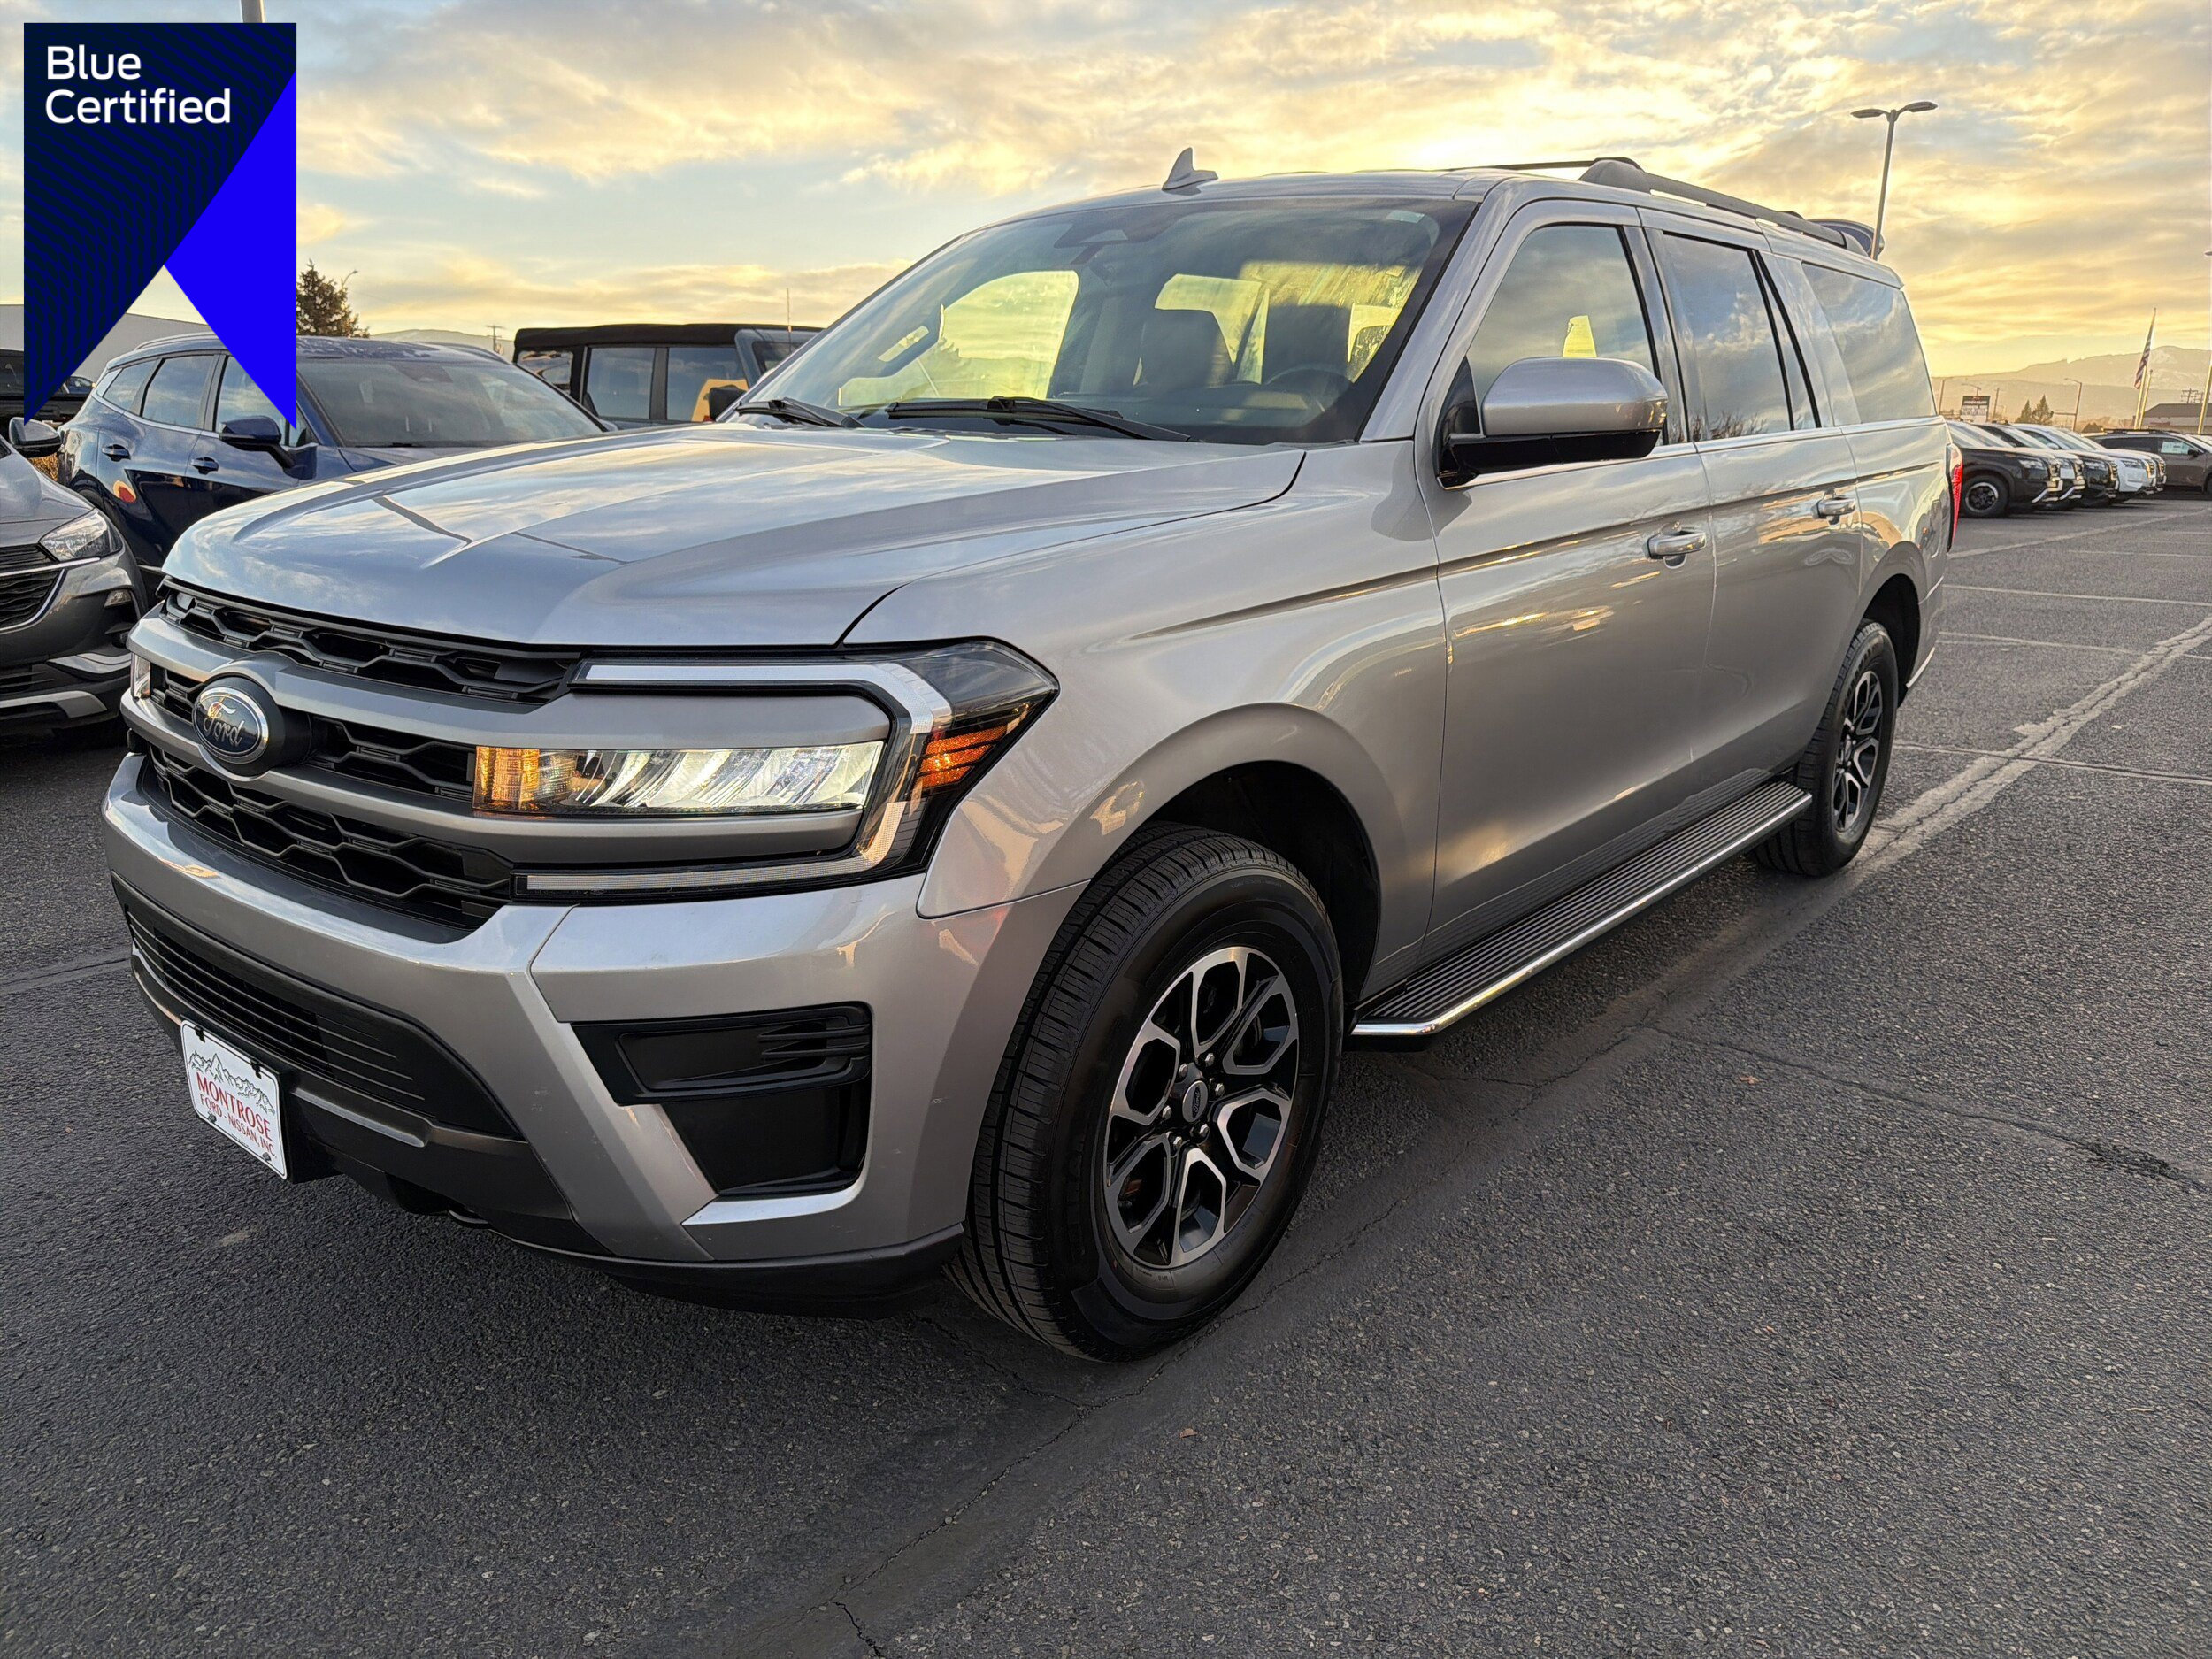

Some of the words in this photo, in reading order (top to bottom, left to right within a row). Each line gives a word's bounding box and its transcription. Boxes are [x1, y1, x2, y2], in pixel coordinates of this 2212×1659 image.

[203, 702, 244, 747] Ford
[196, 1072, 273, 1142] MONTROSE
[200, 1094, 222, 1118] FORD
[228, 1114, 260, 1148] NISSAN,
[259, 1136, 278, 1159] INC.
